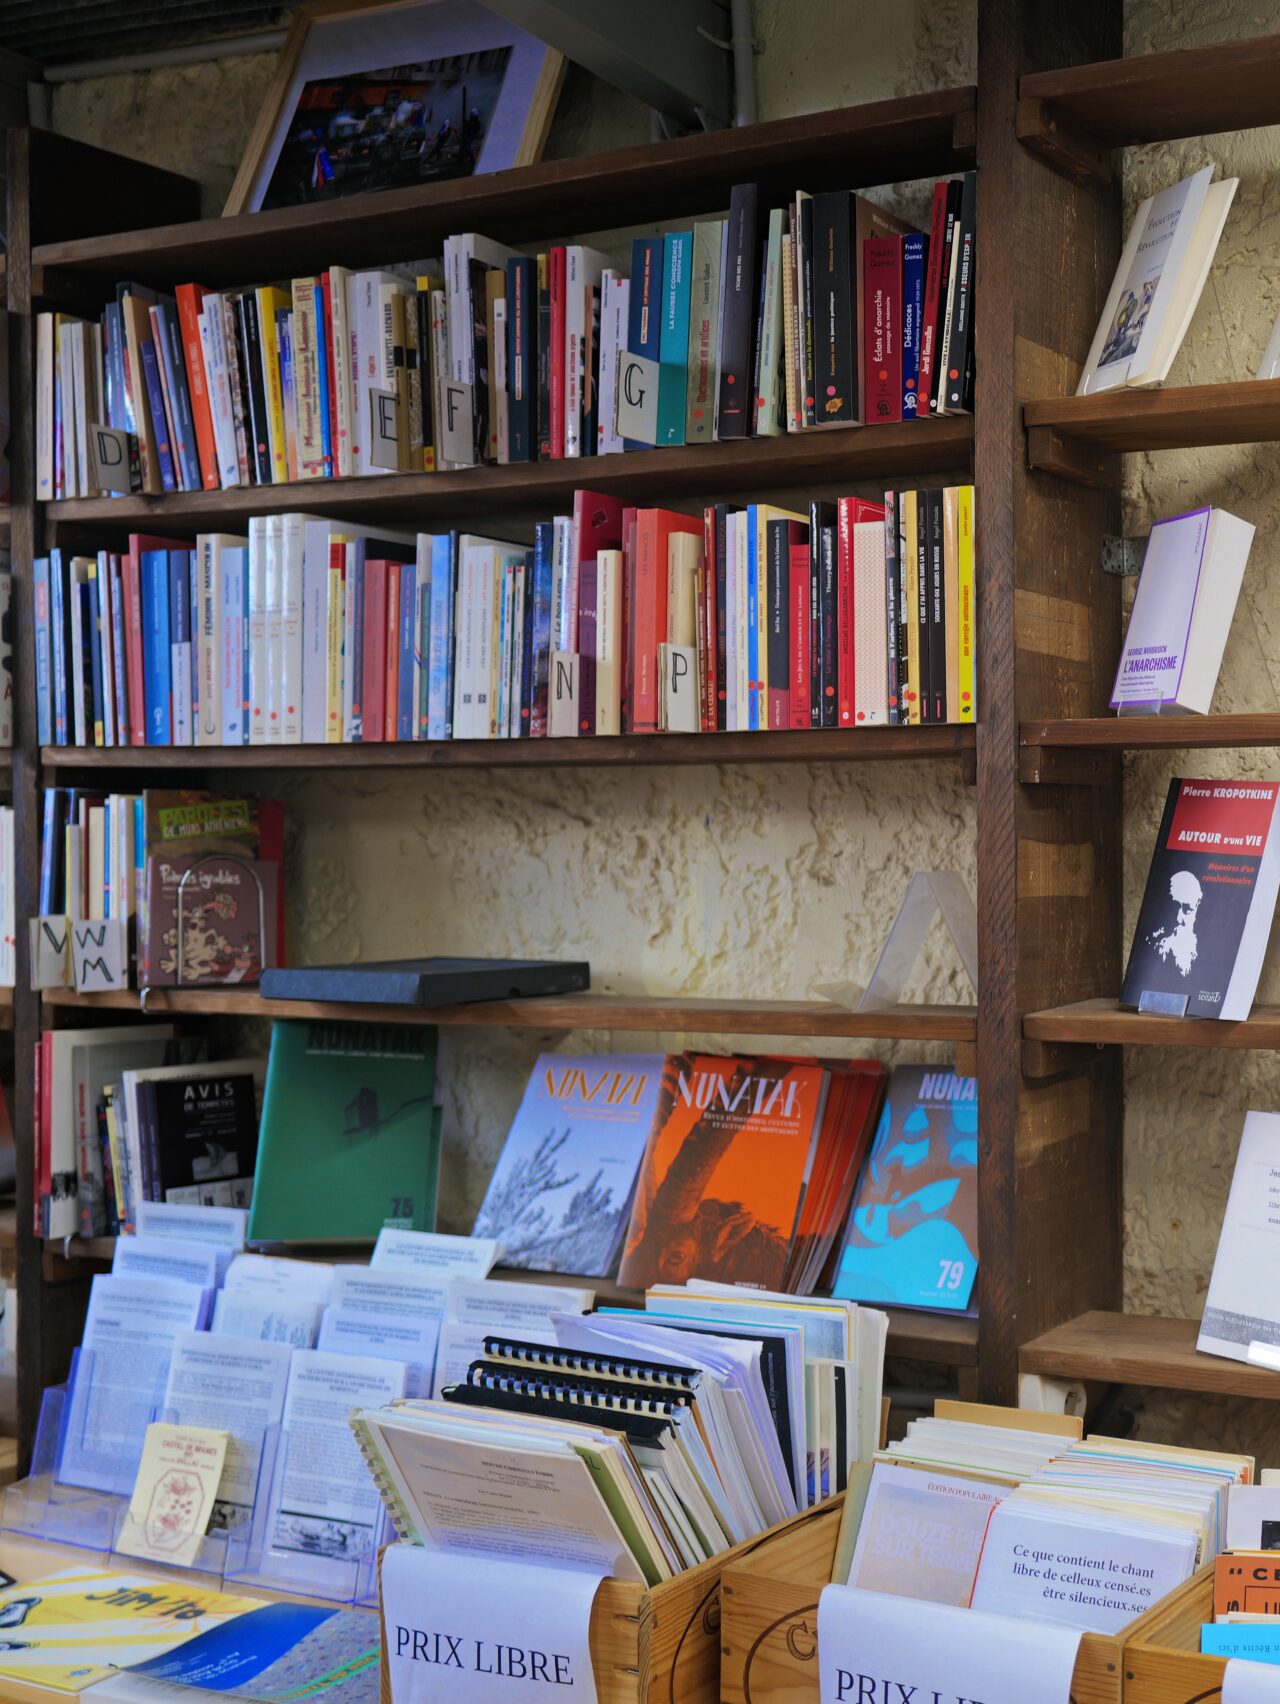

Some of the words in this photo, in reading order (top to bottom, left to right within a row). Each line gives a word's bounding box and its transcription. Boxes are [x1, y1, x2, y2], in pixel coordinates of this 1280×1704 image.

[904, 242, 923, 251] Freddy
[671, 239, 679, 289] CONSCIENCE
[669, 290, 677, 319] FAUSSE
[875, 289, 884, 332] d'anarchie
[668, 320, 675, 330] LA
[904, 303, 913, 348] Dédicaces
[923, 325, 932, 354] Gonzalbo
[874, 333, 883, 363] Éclats
[921, 355, 929, 375] Jordi
[624, 363, 646, 409] G
[446, 387, 466, 432] F
[97, 431, 123, 467] D
[671, 651, 688, 694] P
[1123, 655, 1178, 674] L'ANARCHISME
[556, 660, 574, 701] N
[1182, 785, 1213, 798] Pierre
[1213, 787, 1274, 801] KROPOTKINE
[1177, 830, 1222, 844] AUTOUR
[1223, 836, 1245, 846] D'UNE
[1245, 834, 1263, 847] VIE
[1202, 873, 1253, 886] révolutionnaire
[1207, 861, 1240, 874] Mémoires
[1240, 864, 1256, 874] d'un
[75, 925, 107, 949] W
[82, 955, 114, 985] M
[184, 1081, 235, 1100] AVIS
[673, 1071, 807, 1119] NUNATAK
[390, 1198, 415, 1217] 75
[936, 1260, 965, 1290] 79
[879, 1513, 954, 1545] DOUZE
[872, 1535, 916, 1562] SUR
[1013, 1544, 1030, 1560] Ce
[1031, 1550, 1055, 1565] que
[1057, 1551, 1107, 1571] contient
[1108, 1558, 1120, 1574] le
[1121, 1561, 1155, 1580] chant
[1013, 1562, 1040, 1580] libre
[1042, 1566, 1058, 1581] de
[1059, 1569, 1102, 1589] celleux
[1104, 1577, 1152, 1598] censé.es
[1042, 1587, 1067, 1602] être
[394, 1625, 466, 1670] PRIX
[473, 1640, 576, 1687] LIBRE
[1218, 1643, 1240, 1655] d'ici
[1242, 1643, 1271, 1654] Récits
[834, 1668, 919, 1704] PRIX
